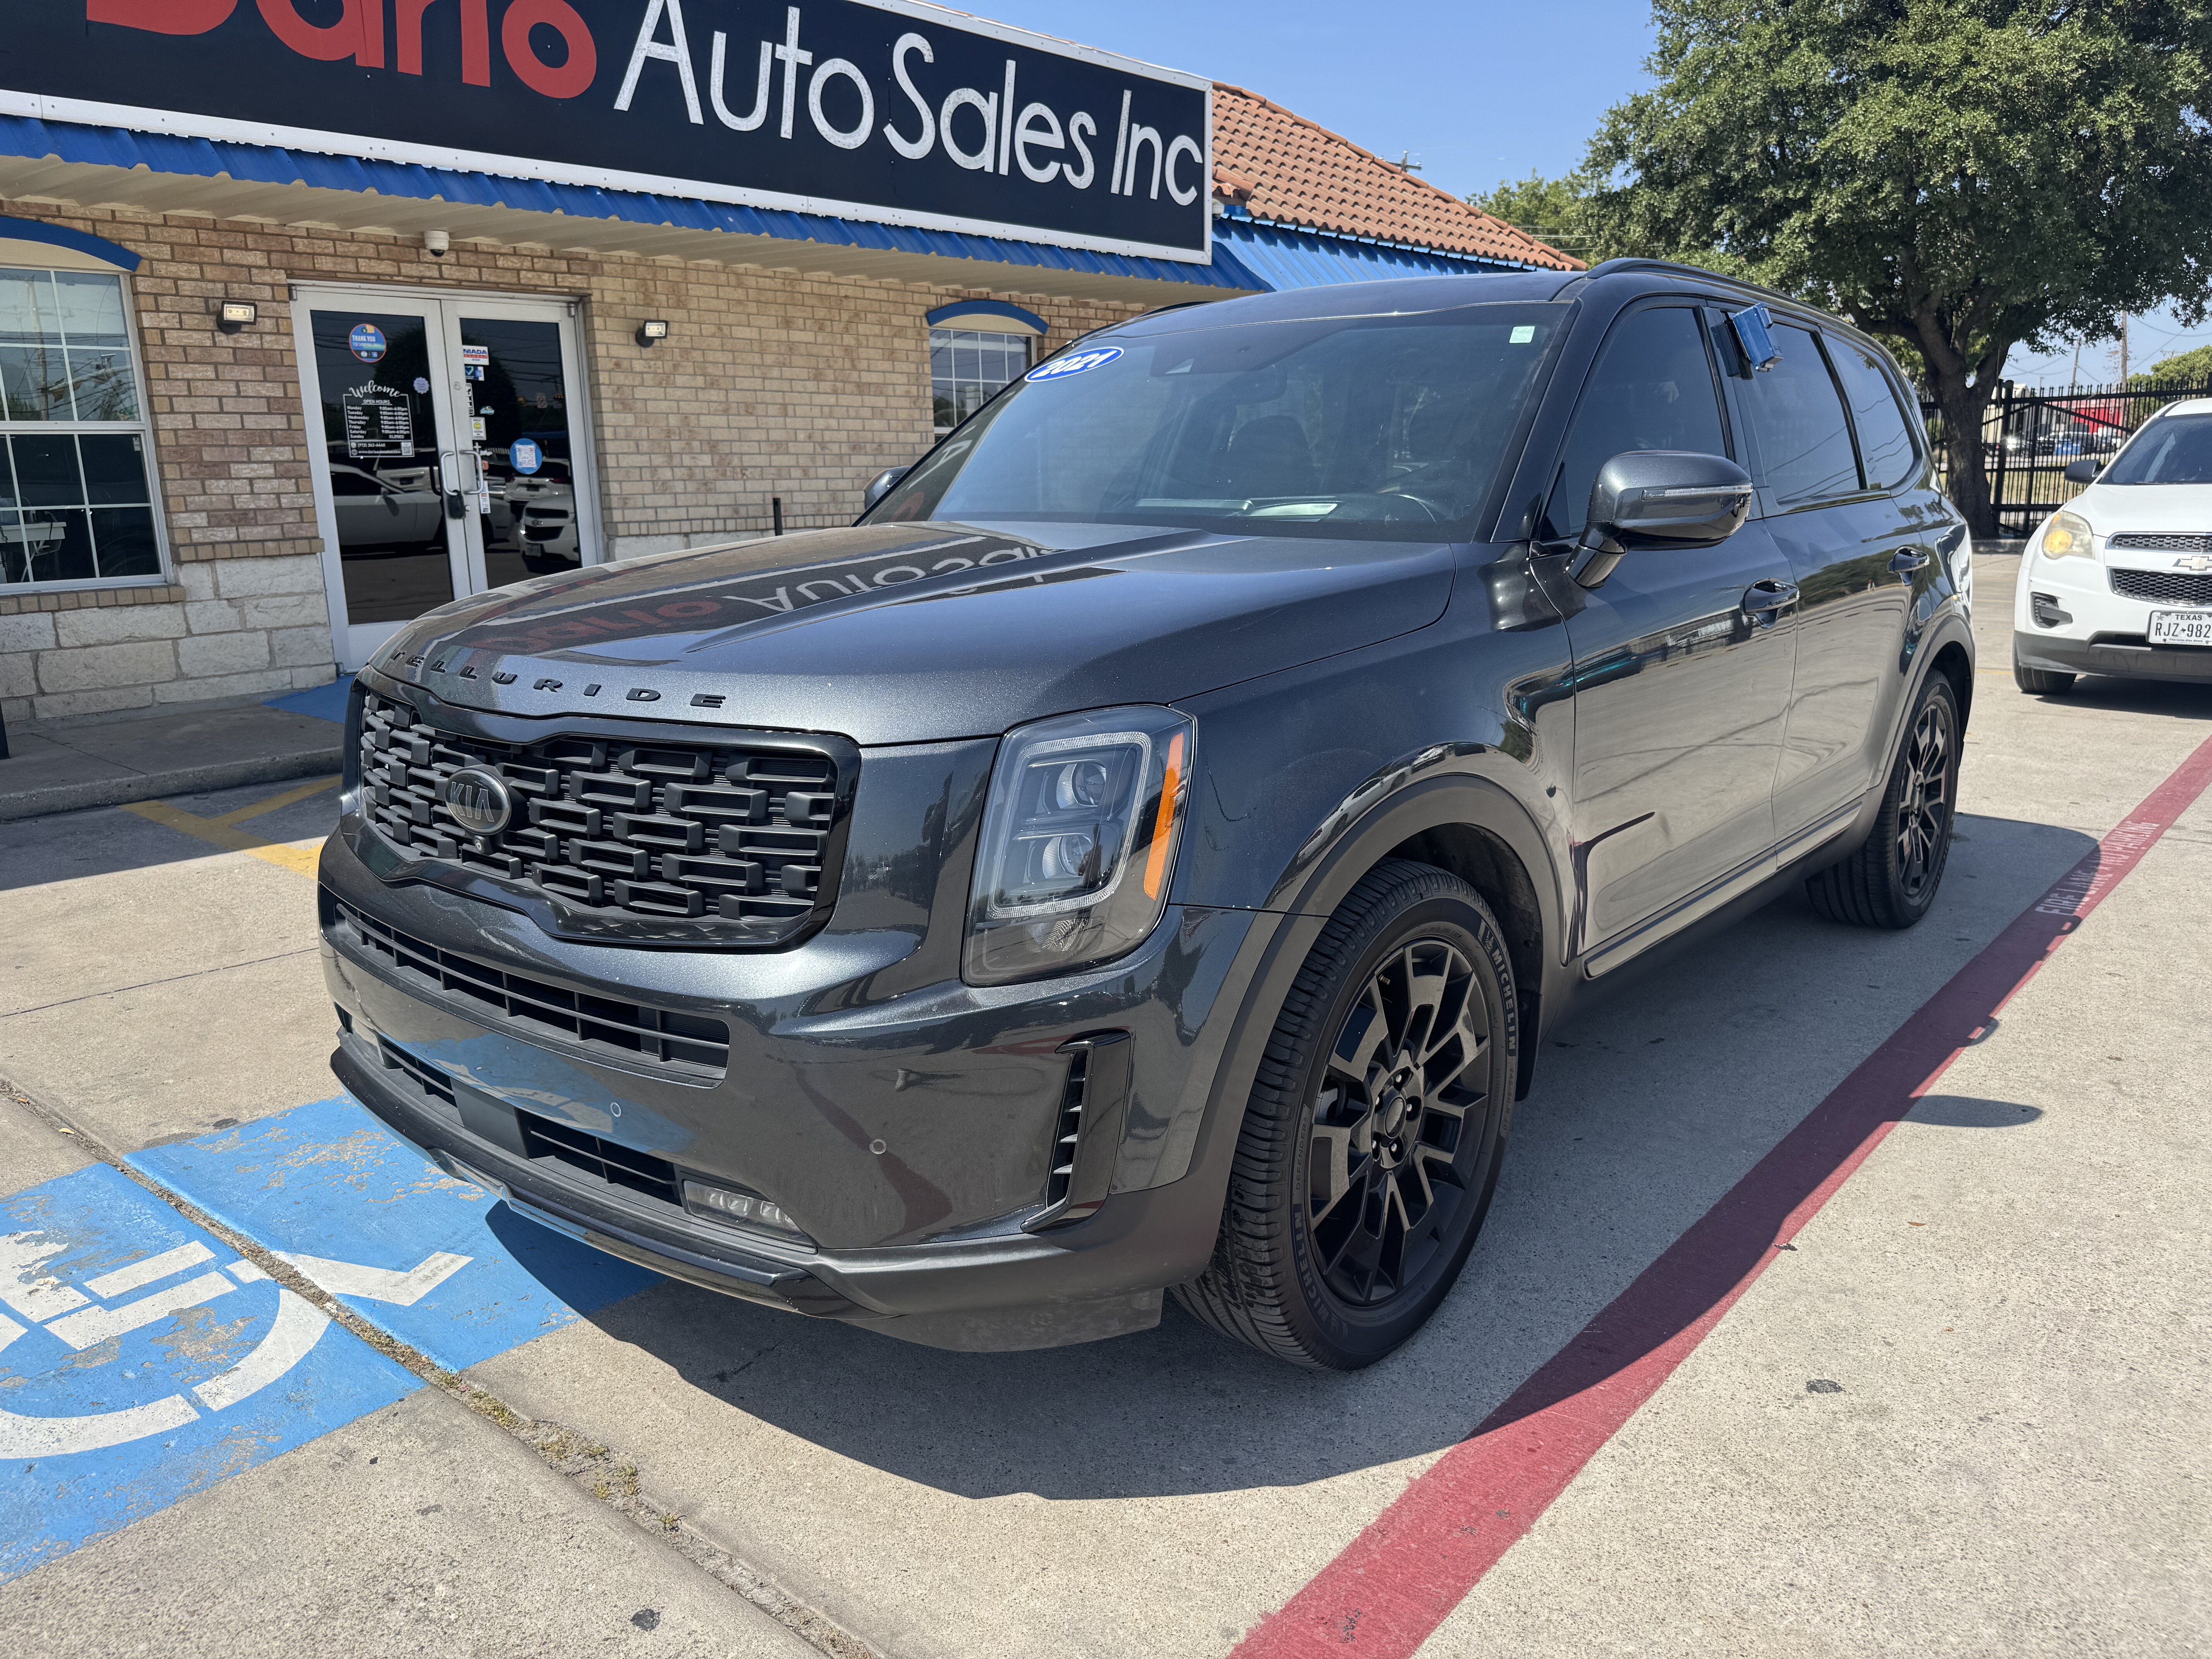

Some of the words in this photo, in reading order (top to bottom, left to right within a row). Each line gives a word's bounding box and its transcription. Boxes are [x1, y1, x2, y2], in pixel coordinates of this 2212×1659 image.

[87, 0, 597, 98] ario
[614, 0, 875, 149] Auto
[883, 33, 1097, 189] Sales
[1111, 90, 1203, 206] Inc
[1030, 350, 1118, 379] 2021
[349, 380, 400, 398] Welcome
[390, 649, 726, 709] TELLURIDE
[450, 781, 495, 822] KIA
[2100, 821, 2161, 853] PARKING
[2056, 870, 2113, 895] LANE
[2034, 893, 2091, 915] FIRE
[1492, 948, 1516, 1050] MICHELIN
[1295, 1212, 1329, 1322] MICHELIN
